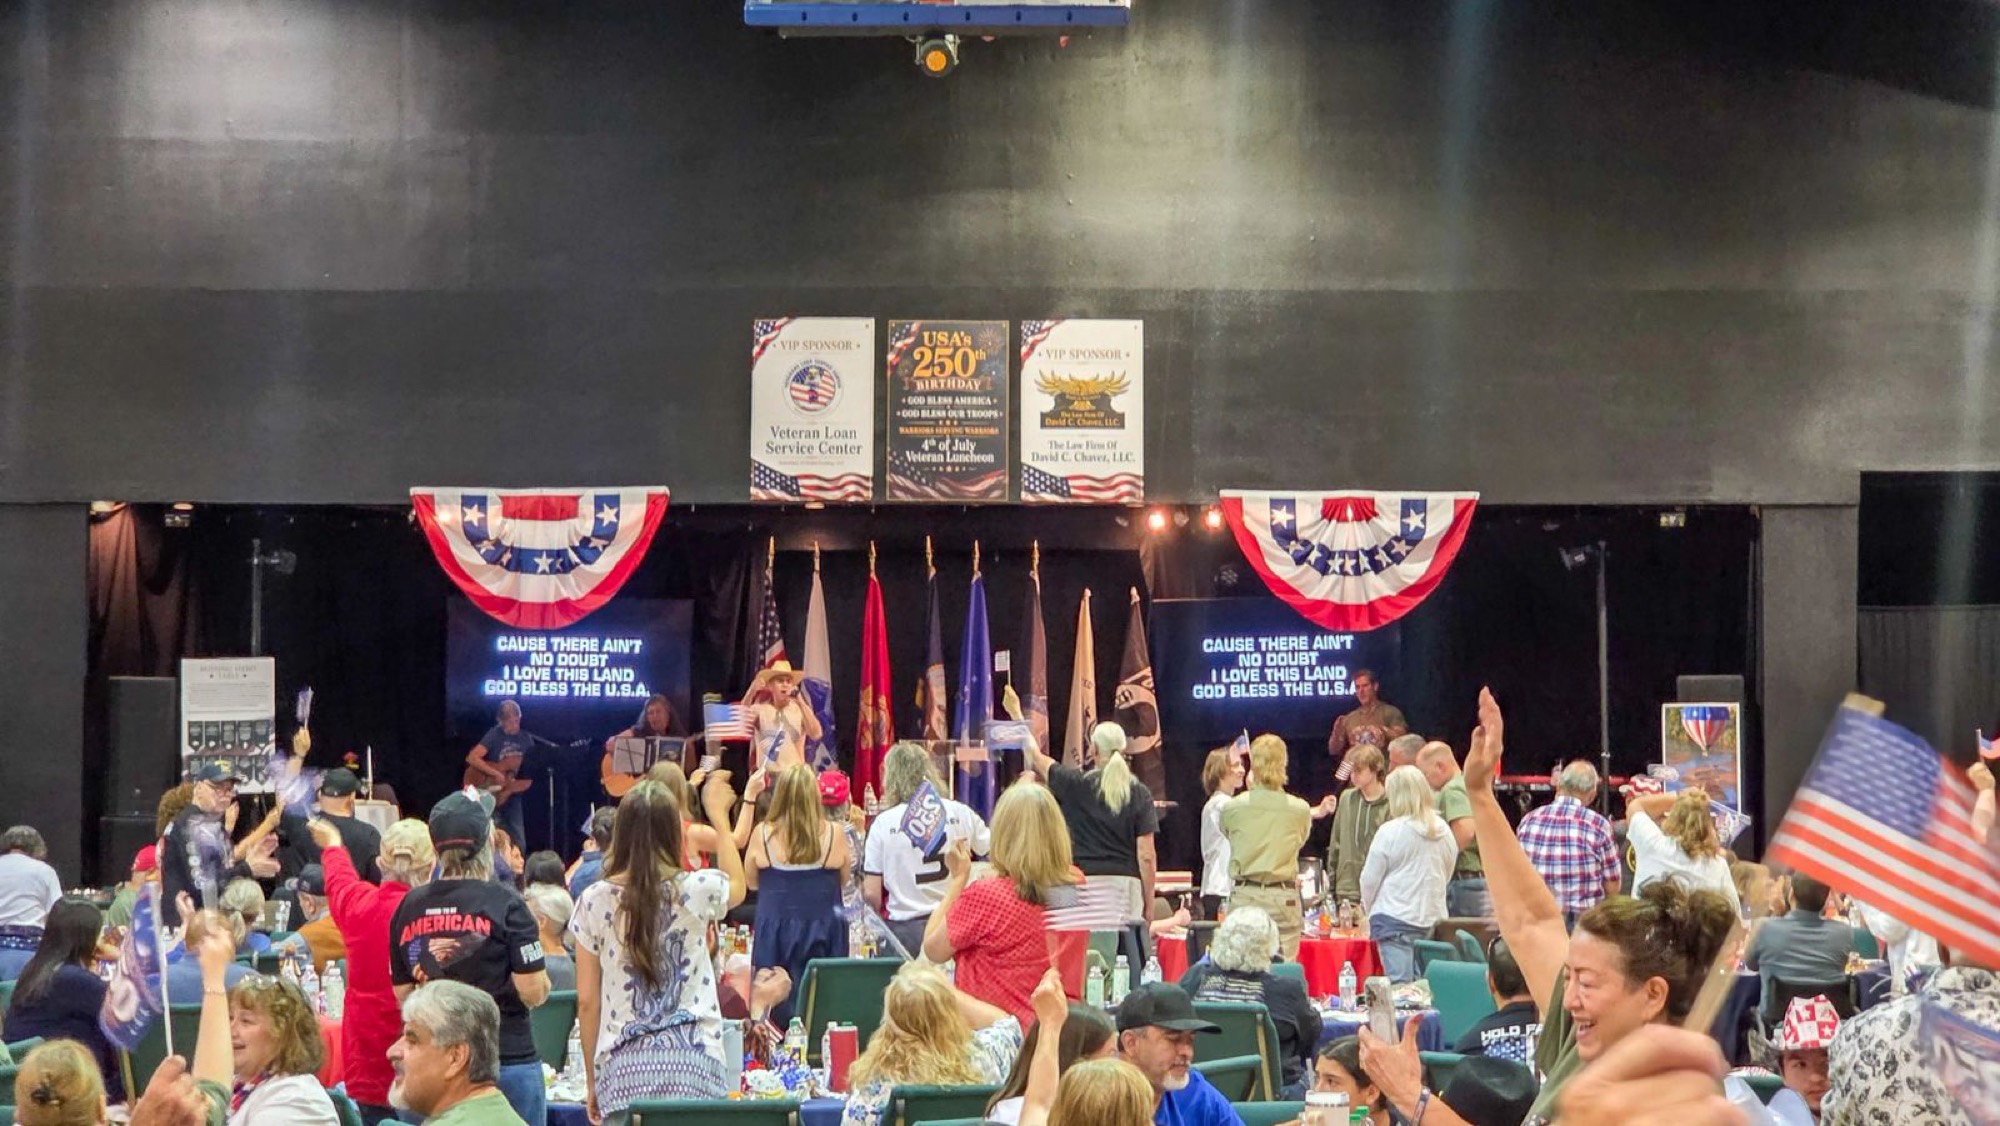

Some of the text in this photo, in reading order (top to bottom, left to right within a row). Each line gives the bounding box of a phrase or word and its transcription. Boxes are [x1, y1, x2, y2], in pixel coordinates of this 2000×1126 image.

[780, 340, 853, 350] VIP SPONSOR
[922, 331, 972, 347] USA's
[1045, 349, 1122, 361] VIP SPONSOR
[916, 379, 981, 391] BIRTHDAY
[907, 396, 992, 406] GOD BLESS AMERICA
[902, 409, 999, 419] GOD BLESS OUR TROOPS
[1045, 417, 1066, 426] David
[1067, 417, 1076, 426] C.
[770, 426, 857, 439] Veteran Loan
[765, 441, 863, 455] Service Center
[921, 439, 976, 453] 4th of July
[1048, 440, 1118, 450] The Law Firm Of
[905, 451, 994, 463] Veteran Luncheon
[1031, 452, 1136, 464] David C. Chavez, LLC.
[496, 636, 643, 654] CAUSE THERE AIN'T
[1203, 635, 1354, 653] CAUSE THERE AIN'T
[530, 652, 609, 667] NO DOUBT
[1238, 651, 1319, 667] NO DOUBT
[503, 665, 635, 682] I LOVE THIS LAND
[1211, 665, 1347, 683] I LOVE THIS LAND
[484, 679, 651, 697] GOD BLESS THE U.S.A.
[1193, 684, 1226, 699] GOD
[1230, 682, 1280, 698] BLESS
[1283, 682, 1314, 697] THE
[400, 914, 491, 946] AMERICAN
[1480, 1025, 1521, 1042] HOLD
